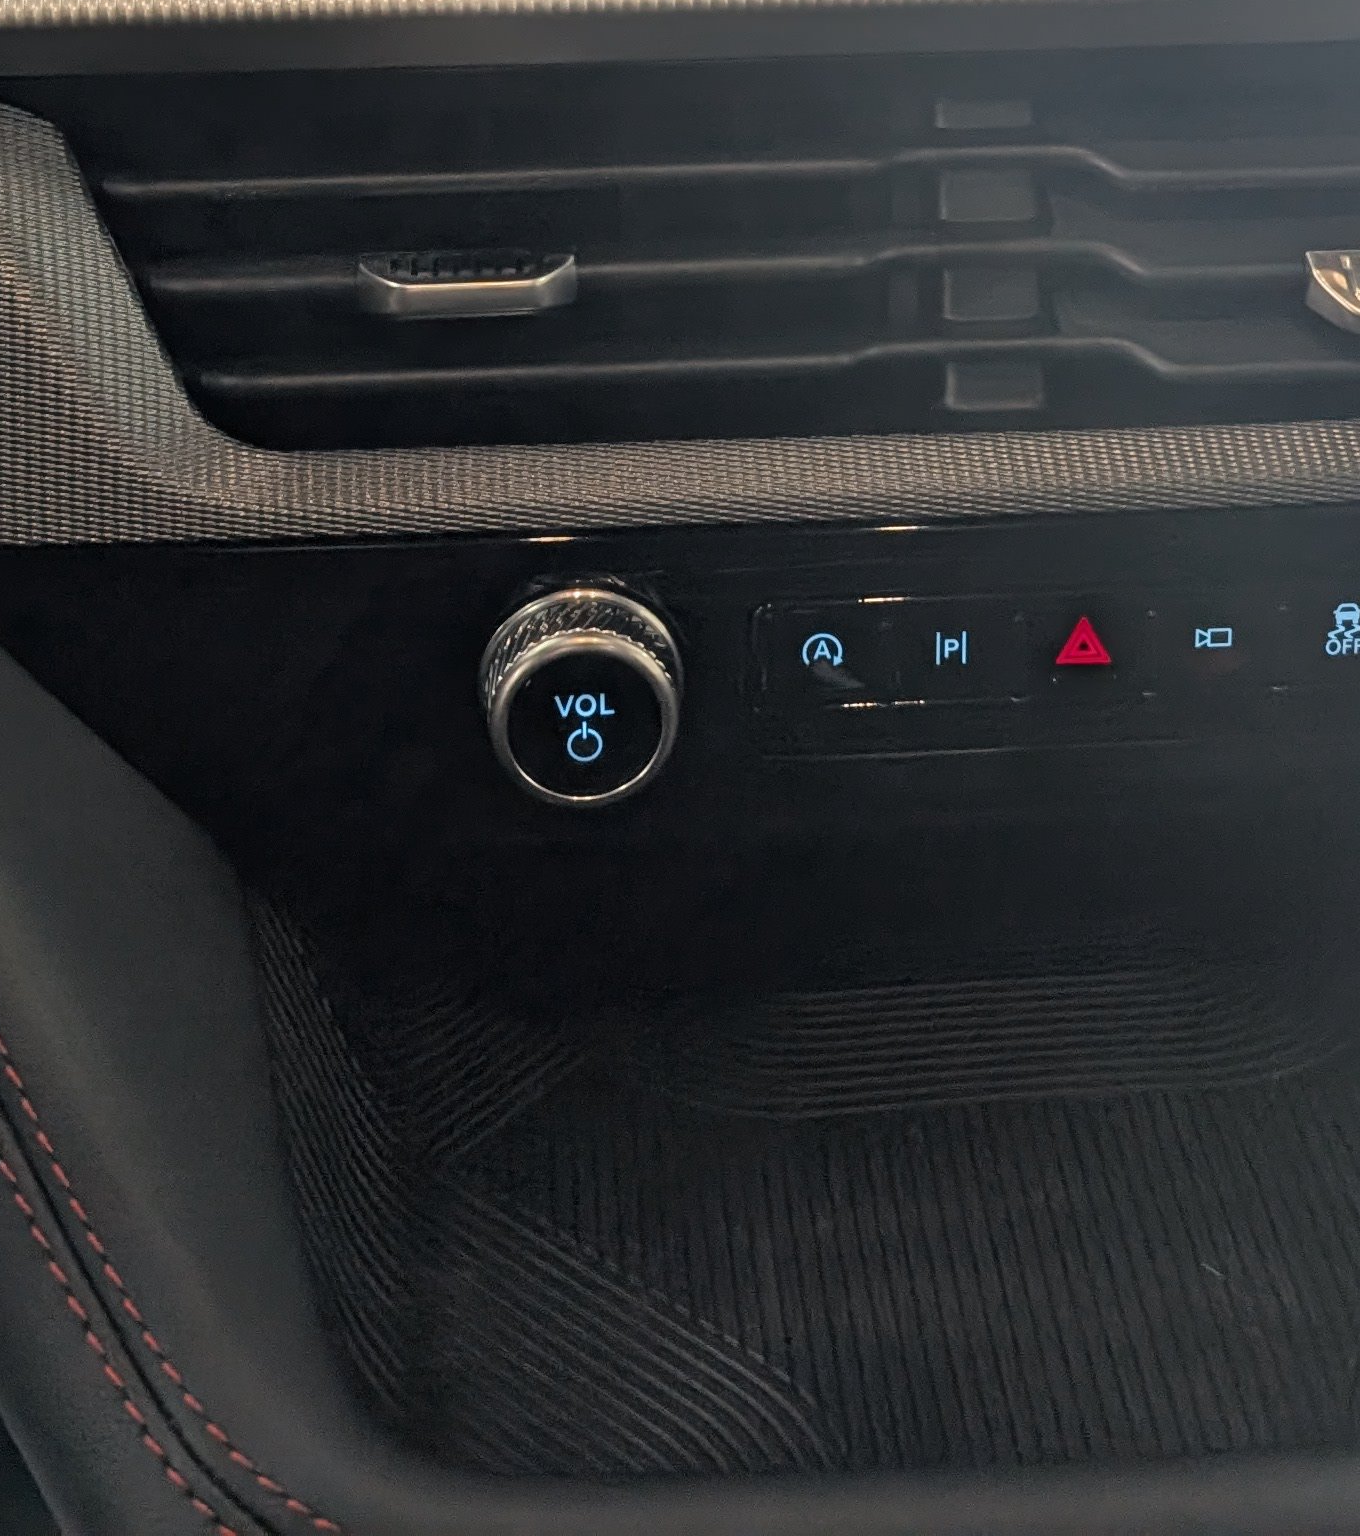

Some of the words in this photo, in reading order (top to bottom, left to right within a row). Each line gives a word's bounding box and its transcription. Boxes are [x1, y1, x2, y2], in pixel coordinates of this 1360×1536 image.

[812, 639, 832, 661] A
[943, 638, 961, 660] P
[554, 693, 616, 718] VOL
